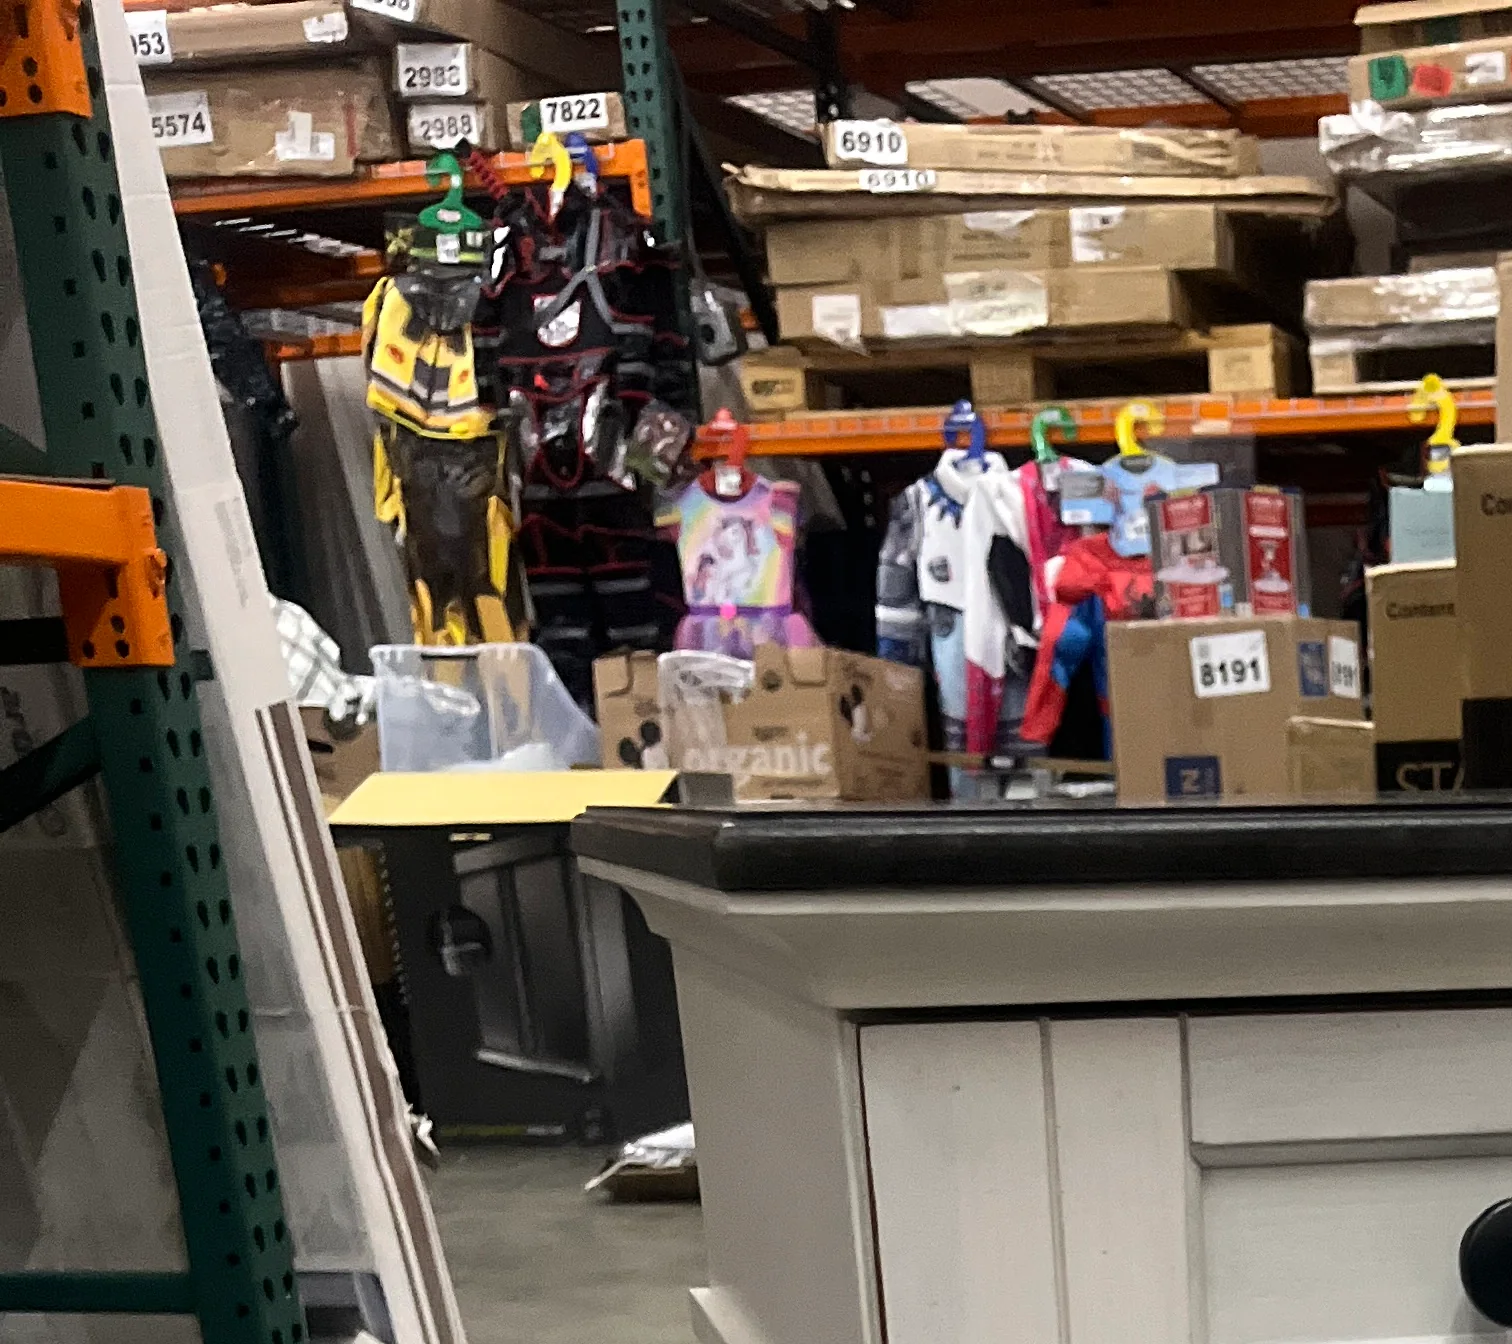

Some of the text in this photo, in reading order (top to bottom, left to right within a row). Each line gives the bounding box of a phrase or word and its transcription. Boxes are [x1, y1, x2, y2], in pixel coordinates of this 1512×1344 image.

[130, 32, 165, 57] 53
[545, 99, 601, 123] 7822
[151, 111, 206, 139] 5574
[419, 115, 472, 141] 2988
[841, 130, 901, 153] 6910
[867, 171, 929, 188] 6910
[1200, 657, 1261, 688] 8191
